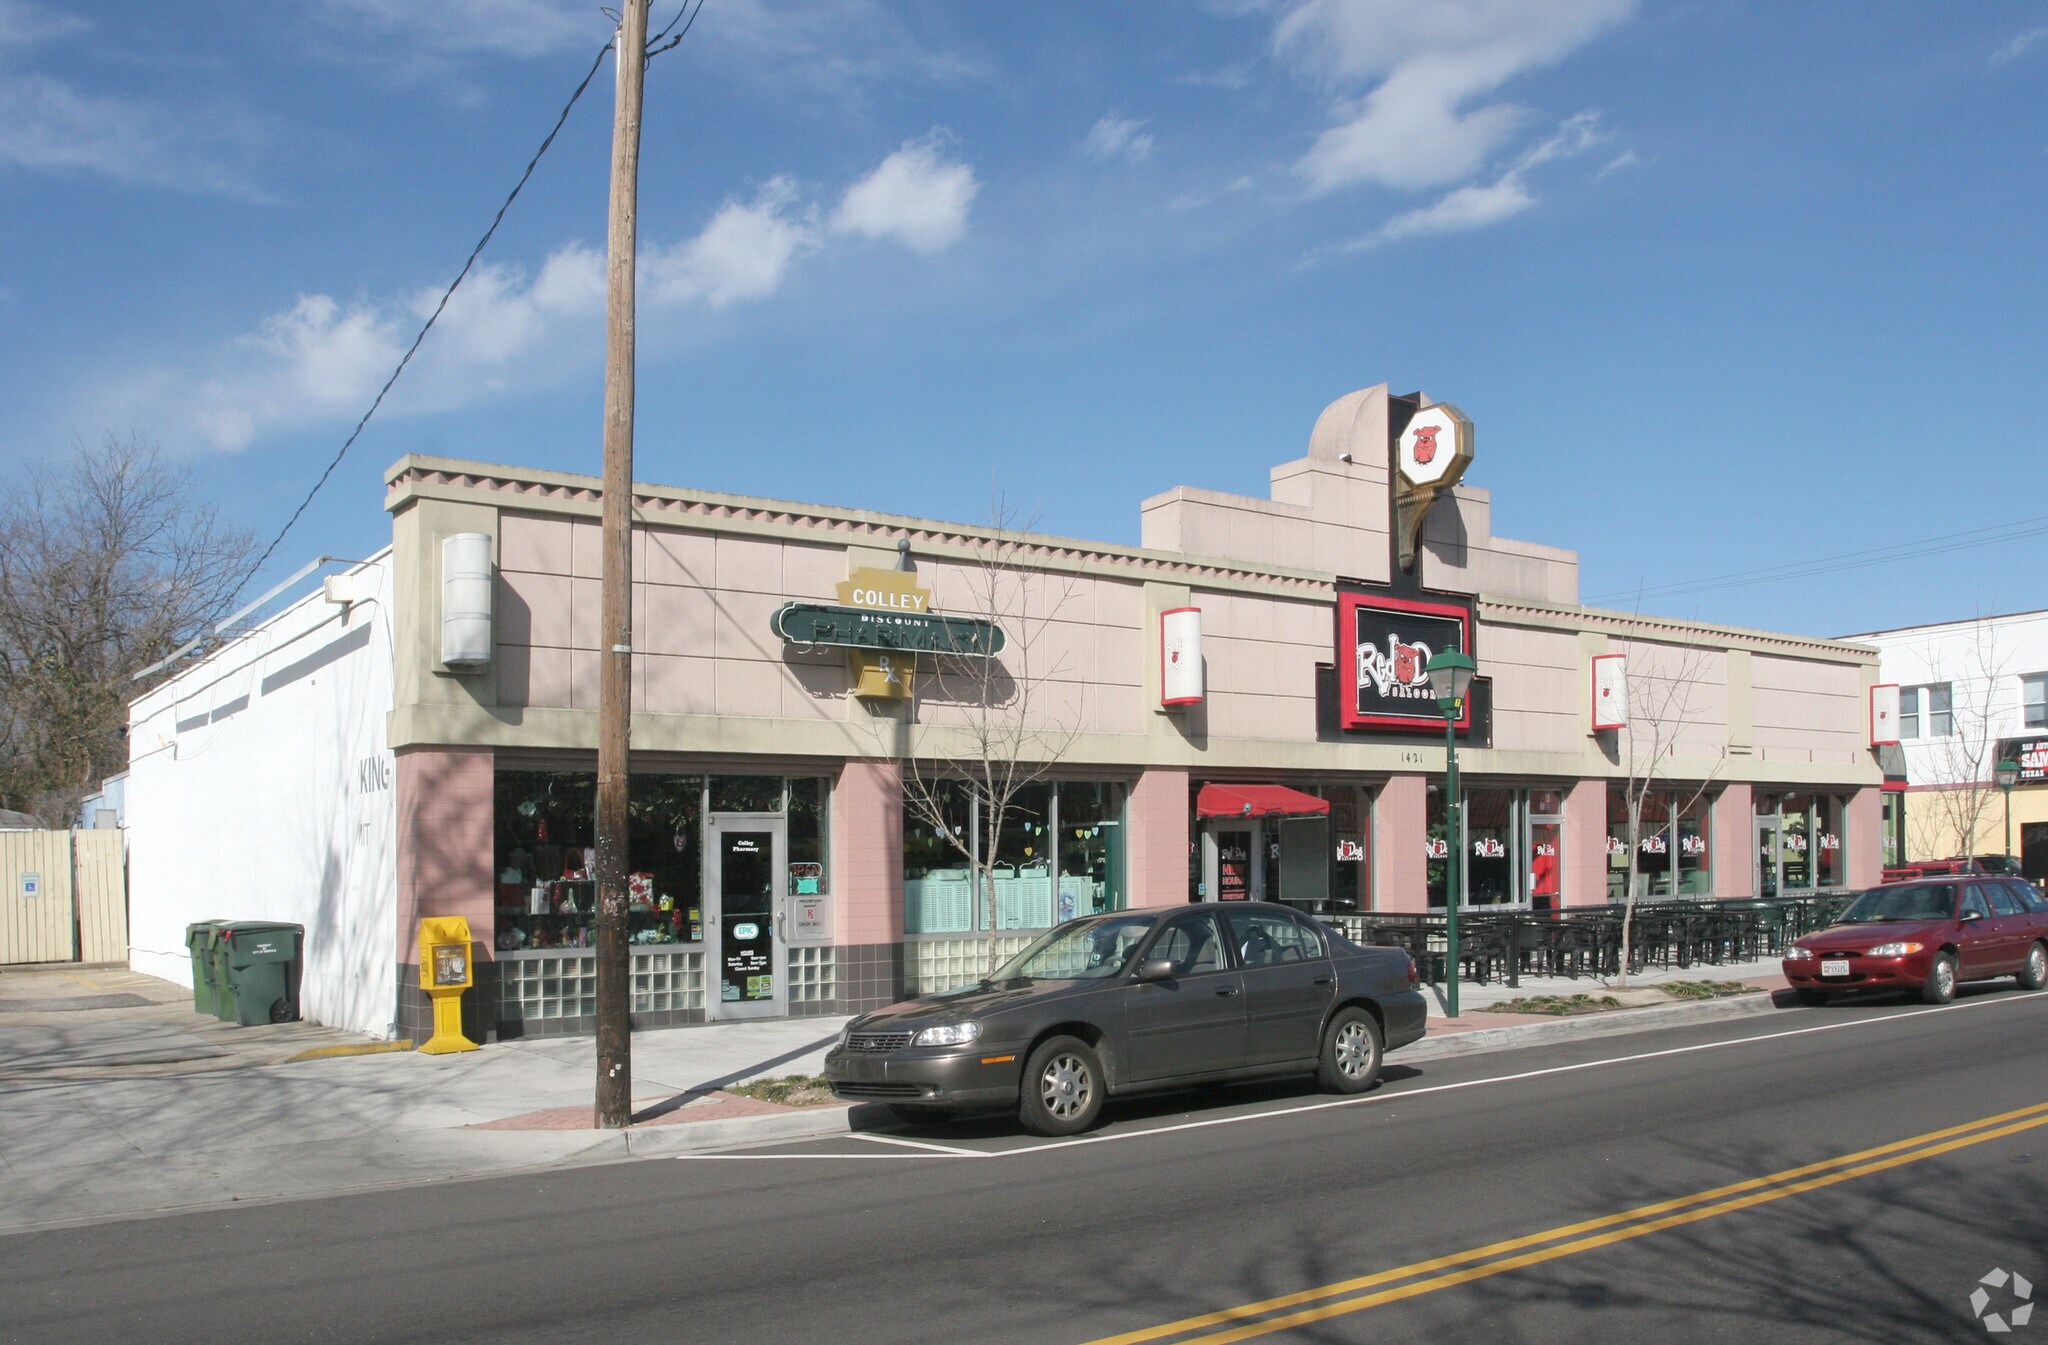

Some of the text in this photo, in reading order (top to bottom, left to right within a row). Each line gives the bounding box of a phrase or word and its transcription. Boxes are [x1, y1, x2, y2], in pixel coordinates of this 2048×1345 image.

[853, 588, 924, 610] COLLEY
[861, 614, 929, 628] DISCOUNT
[1357, 633, 1399, 697] Red
[1401, 752, 1423, 764] 1421
[2021, 770, 2044, 778] TEXAS
[1348, 841, 1364, 861] Dog
[738, 926, 754, 935] EPIC
